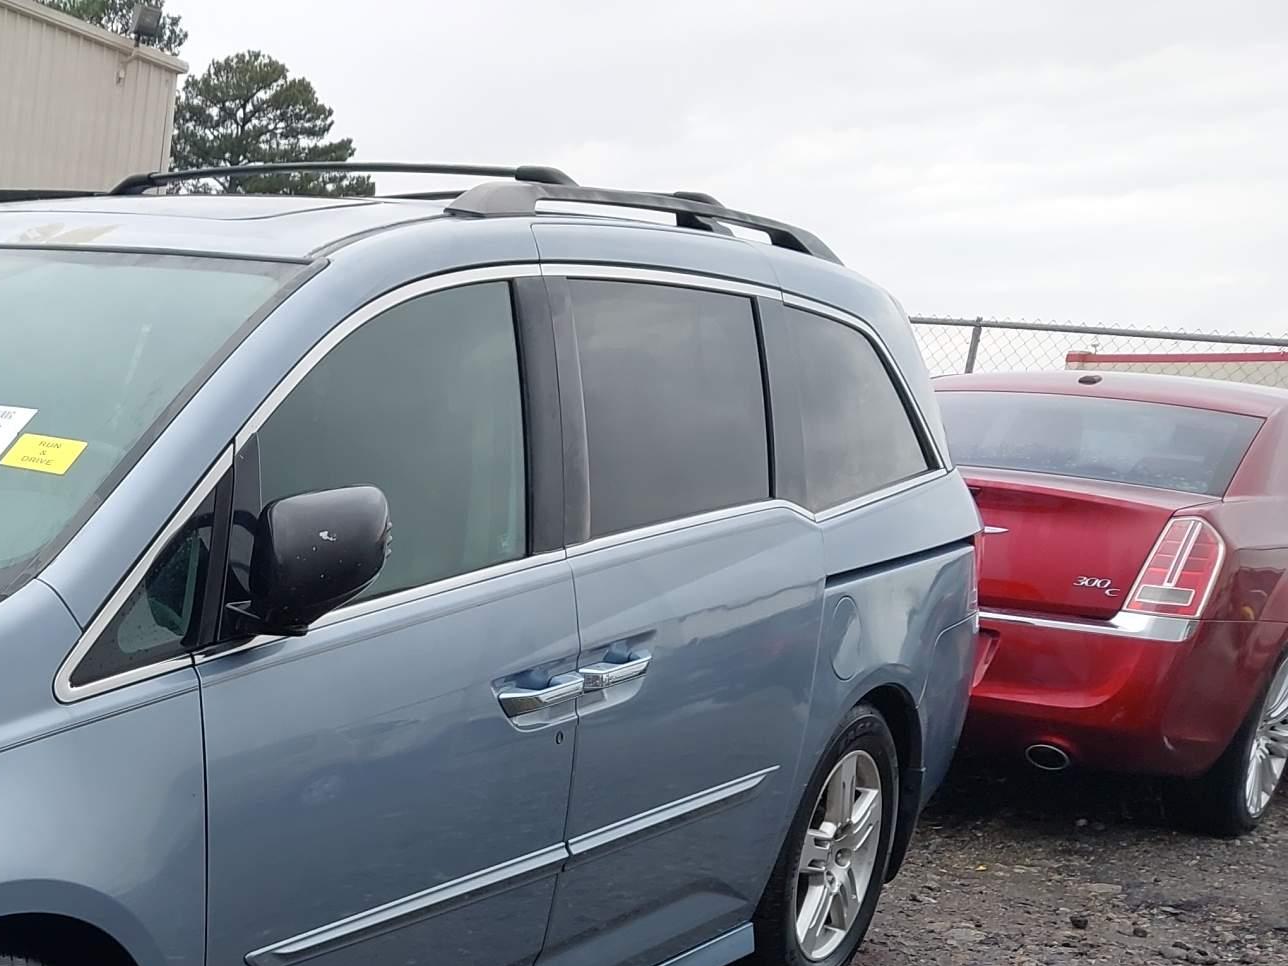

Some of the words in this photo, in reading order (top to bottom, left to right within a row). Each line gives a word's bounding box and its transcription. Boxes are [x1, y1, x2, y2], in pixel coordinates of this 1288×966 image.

[38, 440, 62, 449] RUN
[20, 455, 55, 466] DRIVE
[1072, 575, 1111, 588] 300
[1104, 588, 1121, 597] C
